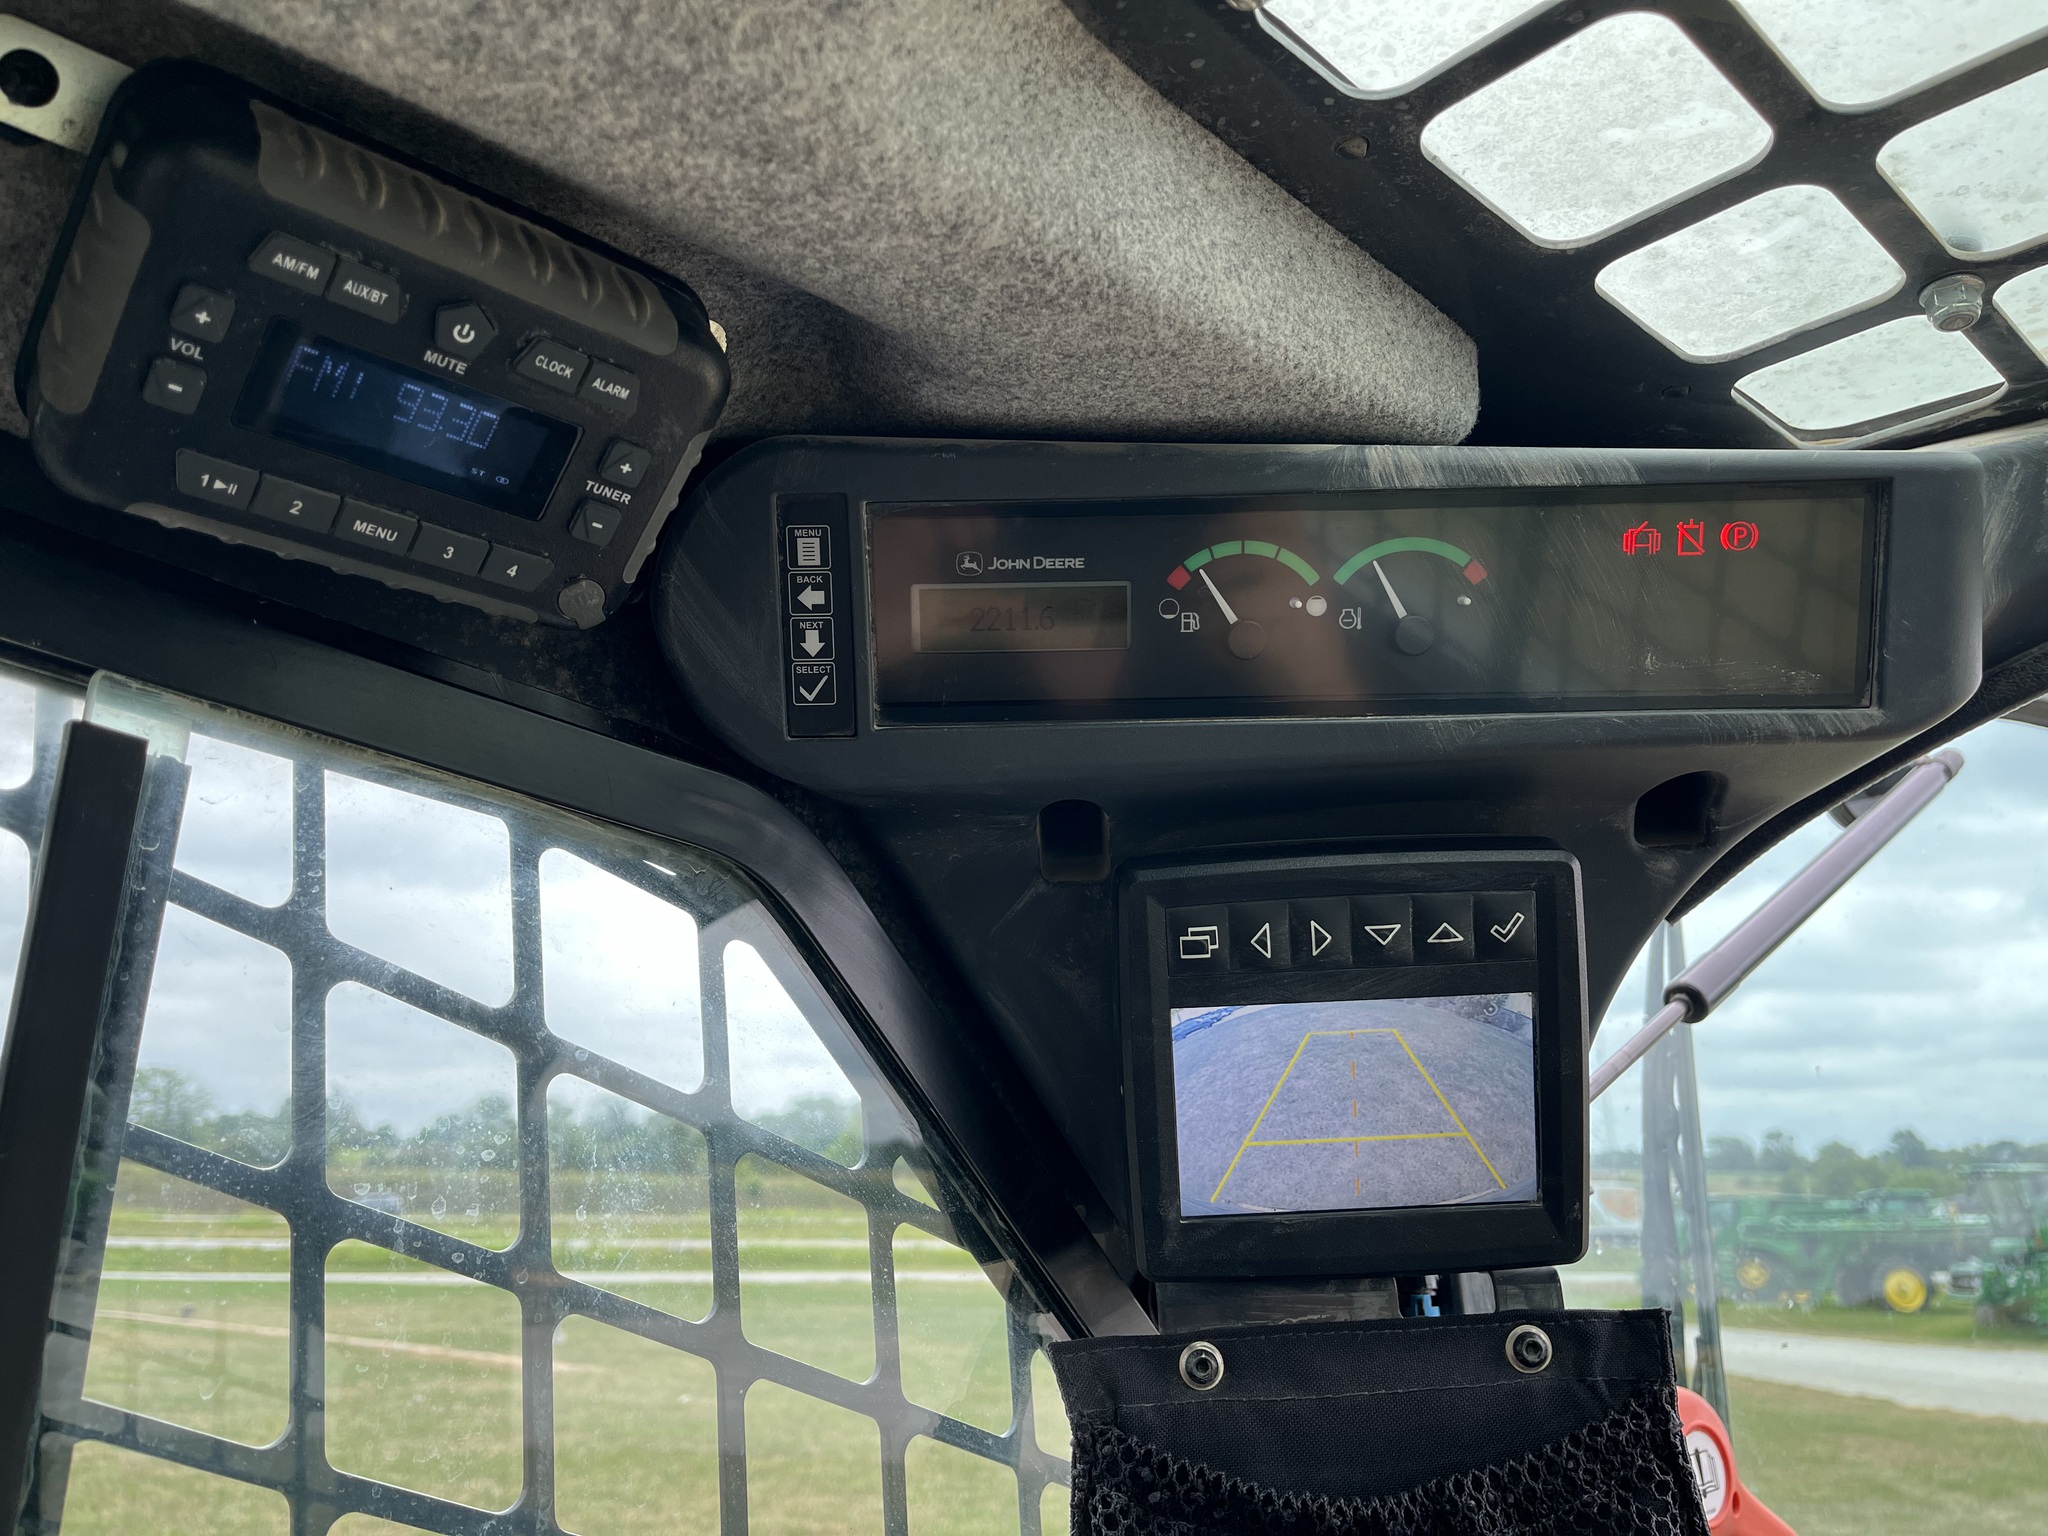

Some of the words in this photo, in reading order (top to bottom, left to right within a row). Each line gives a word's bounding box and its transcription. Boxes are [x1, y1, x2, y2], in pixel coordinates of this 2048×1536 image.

[272, 253, 320, 281] AM/FM
[343, 280, 388, 306] AUX/BT
[170, 338, 204, 360] VOL
[423, 350, 468, 375] MUTE
[535, 354, 574, 379] CLOCK
[591, 377, 630, 400] ALARM
[470, 467, 486, 477] ST
[201, 474, 210, 487] 1
[585, 480, 632, 505] TUNER
[289, 500, 303, 515] 2
[353, 519, 398, 542] MENU
[794, 529, 822, 537] MENU
[443, 546, 454, 559] 3
[506, 564, 518, 577] 4
[987, 556, 1031, 570] JOHN
[1033, 556, 1085, 570] DEERE
[796, 575, 823, 584] BACK
[799, 621, 823, 629] NEXT
[969, 606, 1054, 632] 2211.6
[796, 665, 832, 674] SELECT
